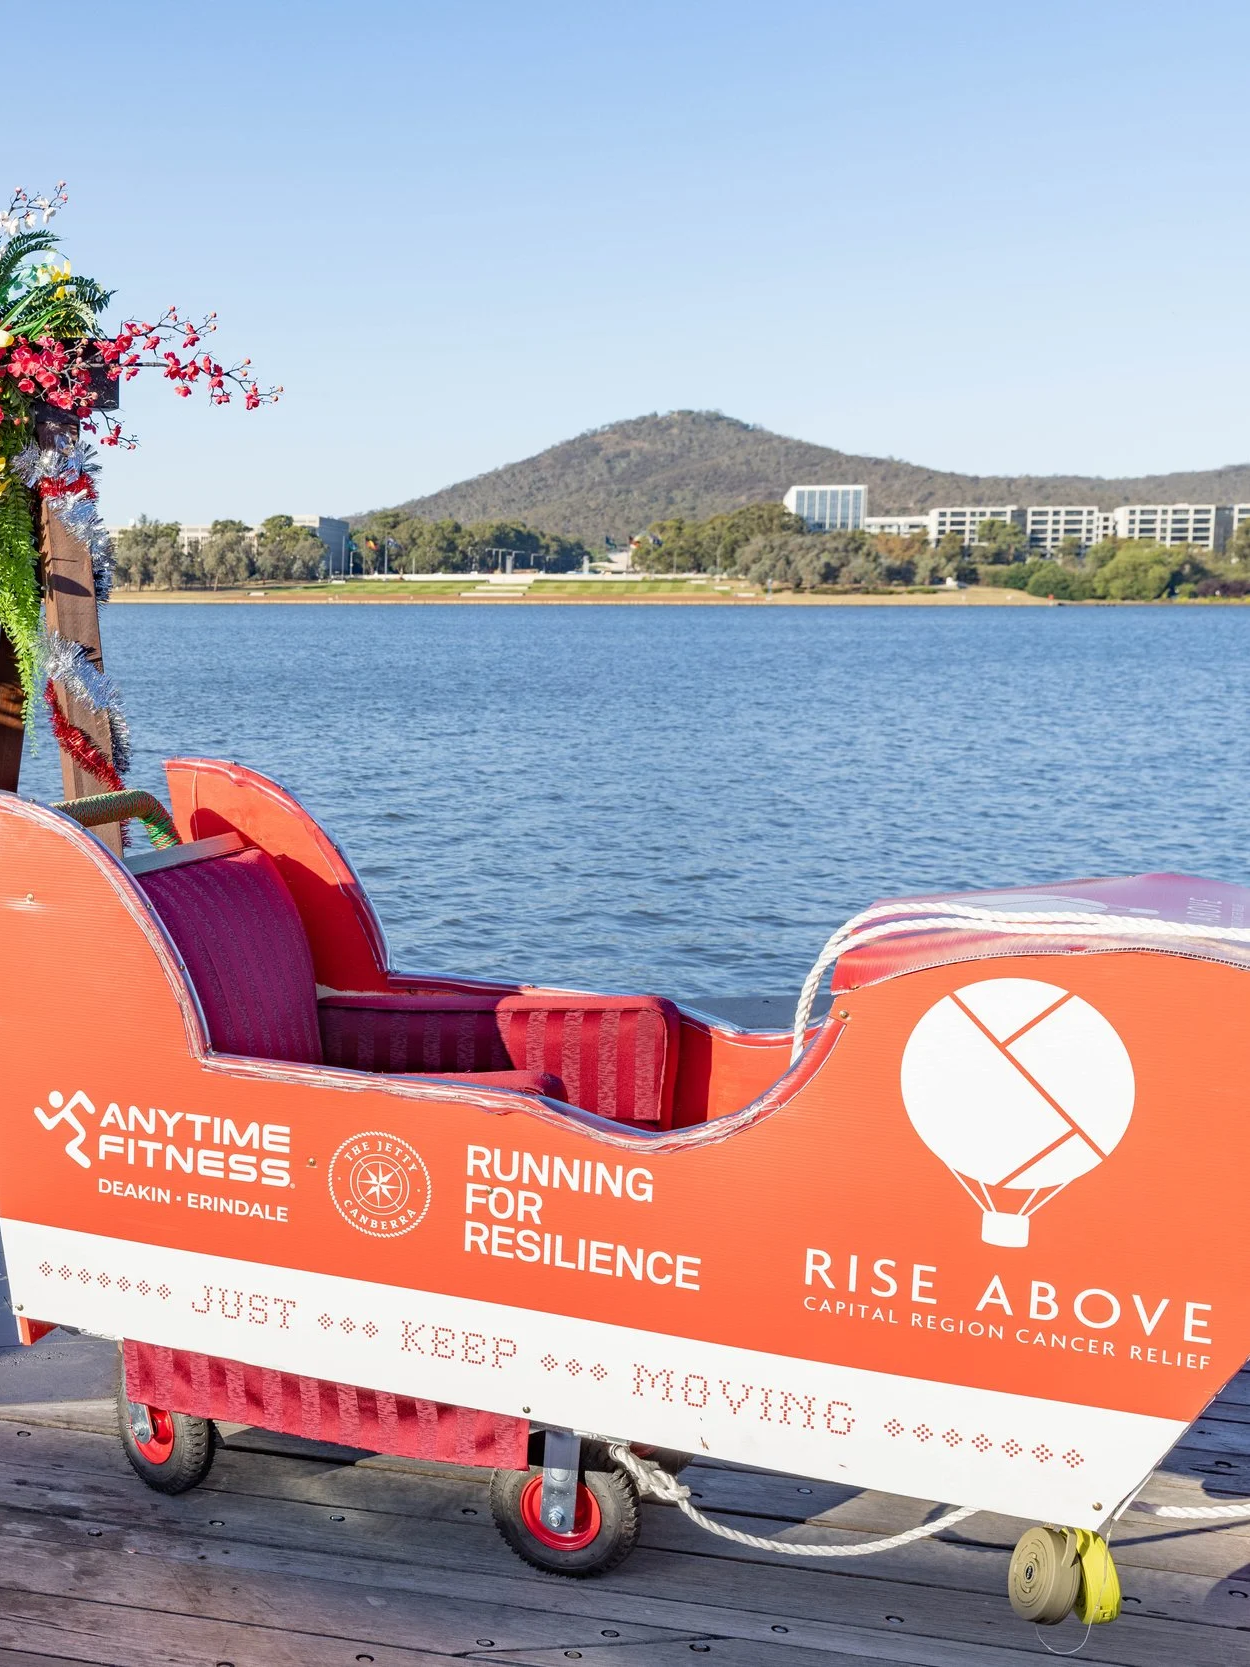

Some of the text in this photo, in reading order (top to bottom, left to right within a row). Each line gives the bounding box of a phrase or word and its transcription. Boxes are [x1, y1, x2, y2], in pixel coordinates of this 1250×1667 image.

[99, 1102, 291, 1154] ANYTIME
[98, 1134, 292, 1188] FITNESS
[344, 1140, 418, 1171] THE JETTY
[466, 1144, 654, 1203] RUNNING
[98, 1178, 288, 1223] DEAKIN ERINDALE
[344, 1199, 417, 1230] CANBERRA
[465, 1182, 543, 1225] FOR
[464, 1220, 702, 1291] RESILIENCE
[804, 1247, 1212, 1345] RISE ABOVE
[803, 1296, 1211, 1370] CAPITAL REGION CANCER RELIEF
[191, 1284, 857, 1437] JUST KEEP MOVING
